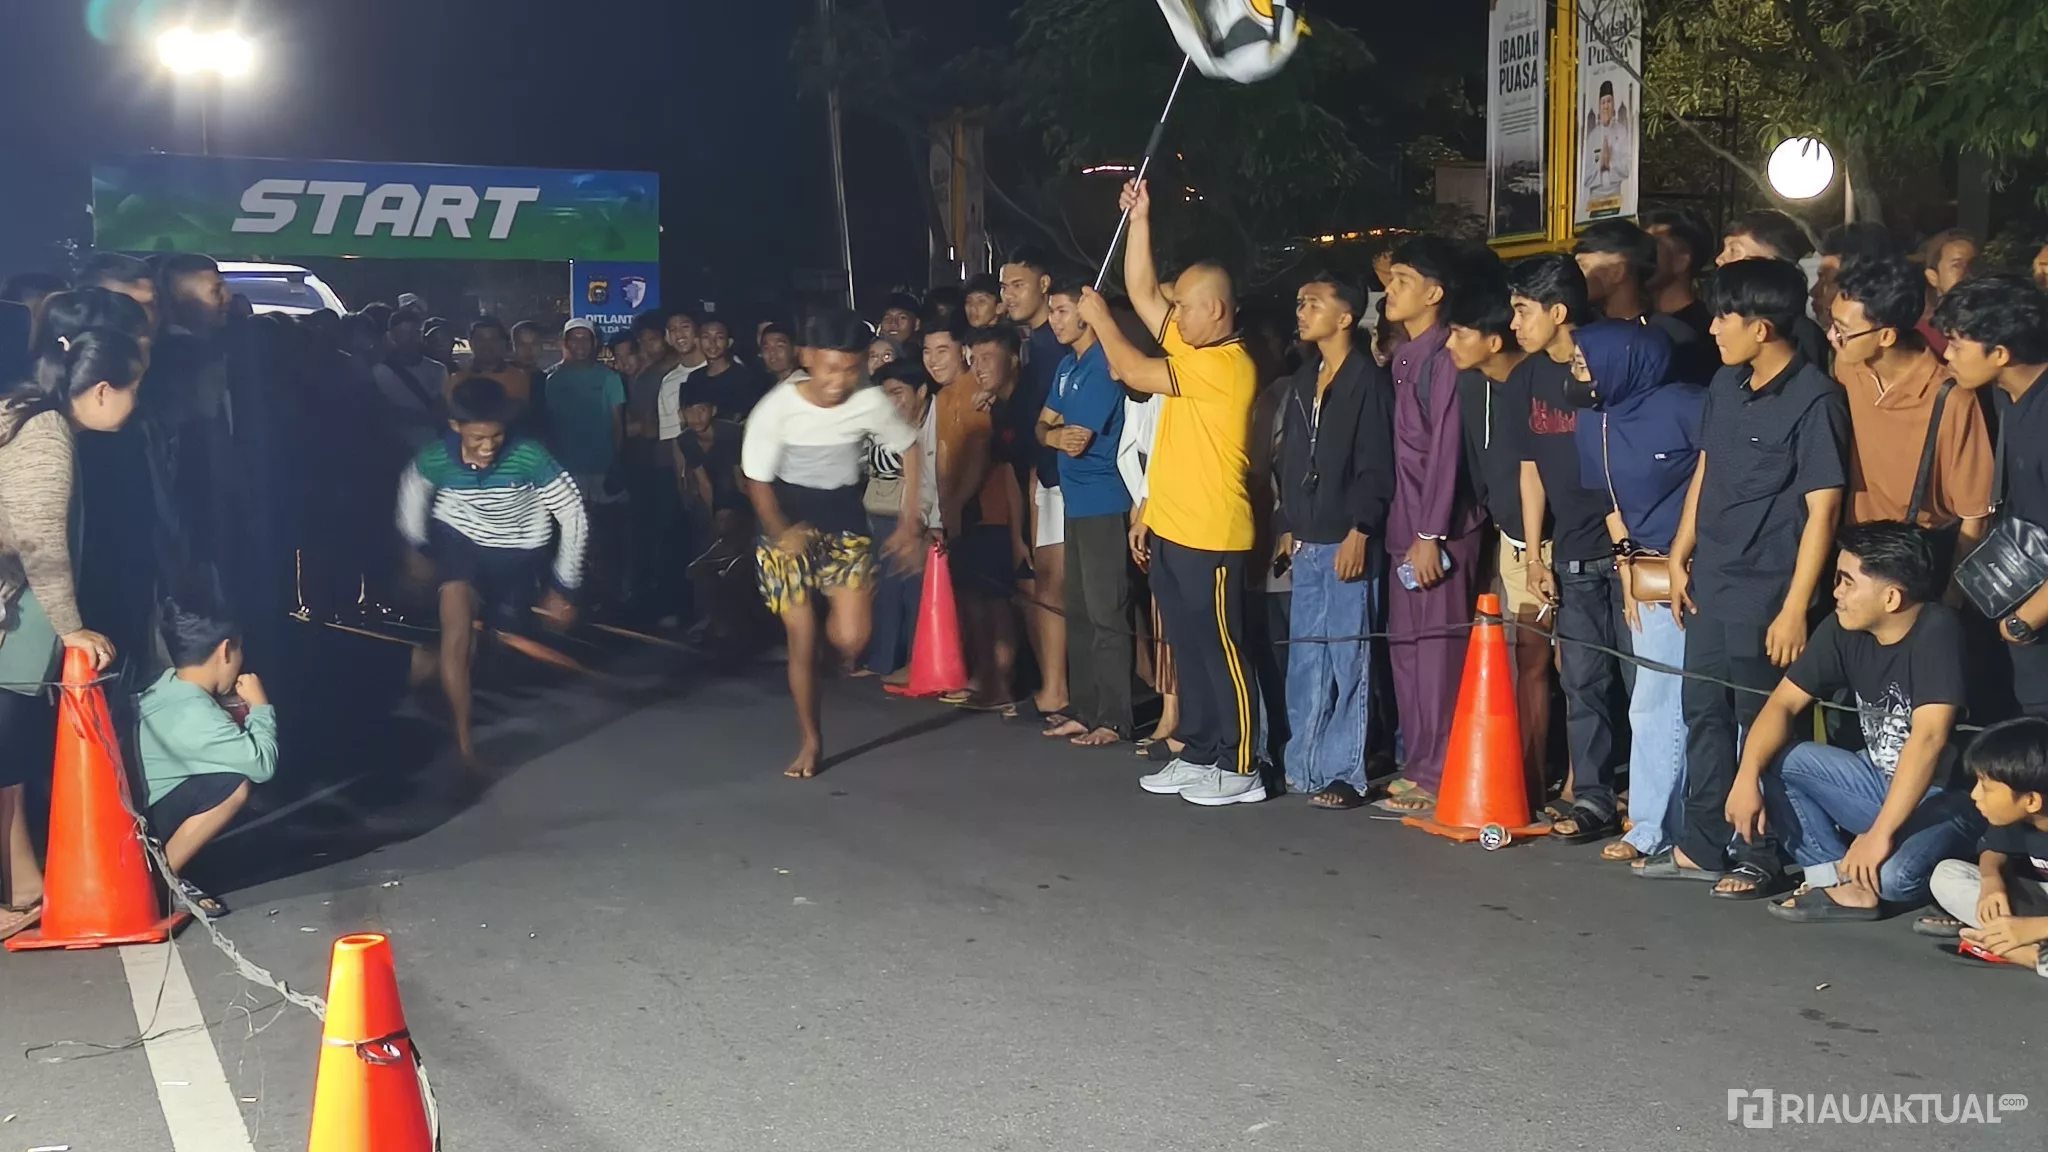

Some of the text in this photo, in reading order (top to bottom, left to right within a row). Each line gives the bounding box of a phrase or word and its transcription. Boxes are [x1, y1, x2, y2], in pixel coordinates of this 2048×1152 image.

[1499, 29, 1539, 66] IBADAH
[1499, 60, 1539, 95] PUASA
[231, 179, 540, 239] START
[585, 314, 634, 324] DITLANT
